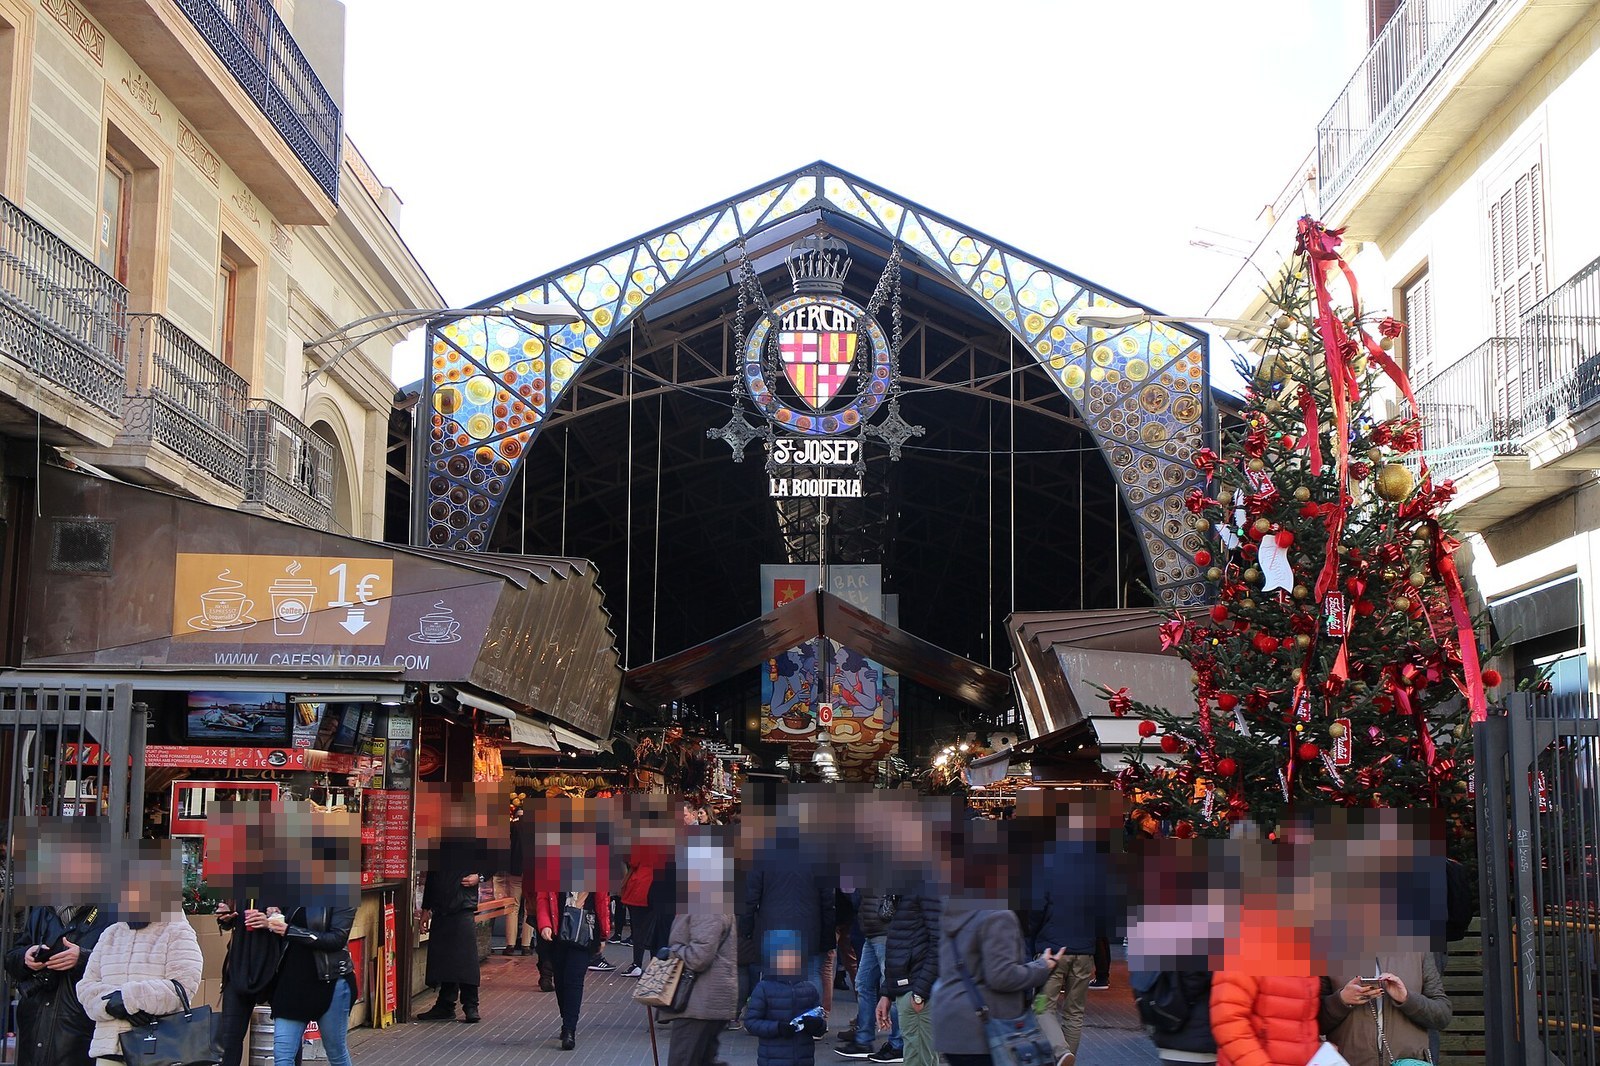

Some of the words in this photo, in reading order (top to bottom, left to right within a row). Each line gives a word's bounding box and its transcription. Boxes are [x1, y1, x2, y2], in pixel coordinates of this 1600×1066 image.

[781, 305, 856, 331] MERCAT
[793, 439, 859, 464] JOSEP
[770, 478, 789, 497] LA
[792, 478, 863, 498] BOQUERIA
[328, 563, 380, 607] 1€
[833, 574, 869, 589] BAR
[280, 606, 303, 615] Coffee
[214, 653, 259, 665] WWW
[393, 654, 430, 670] COM
[821, 708, 830, 721] 6
